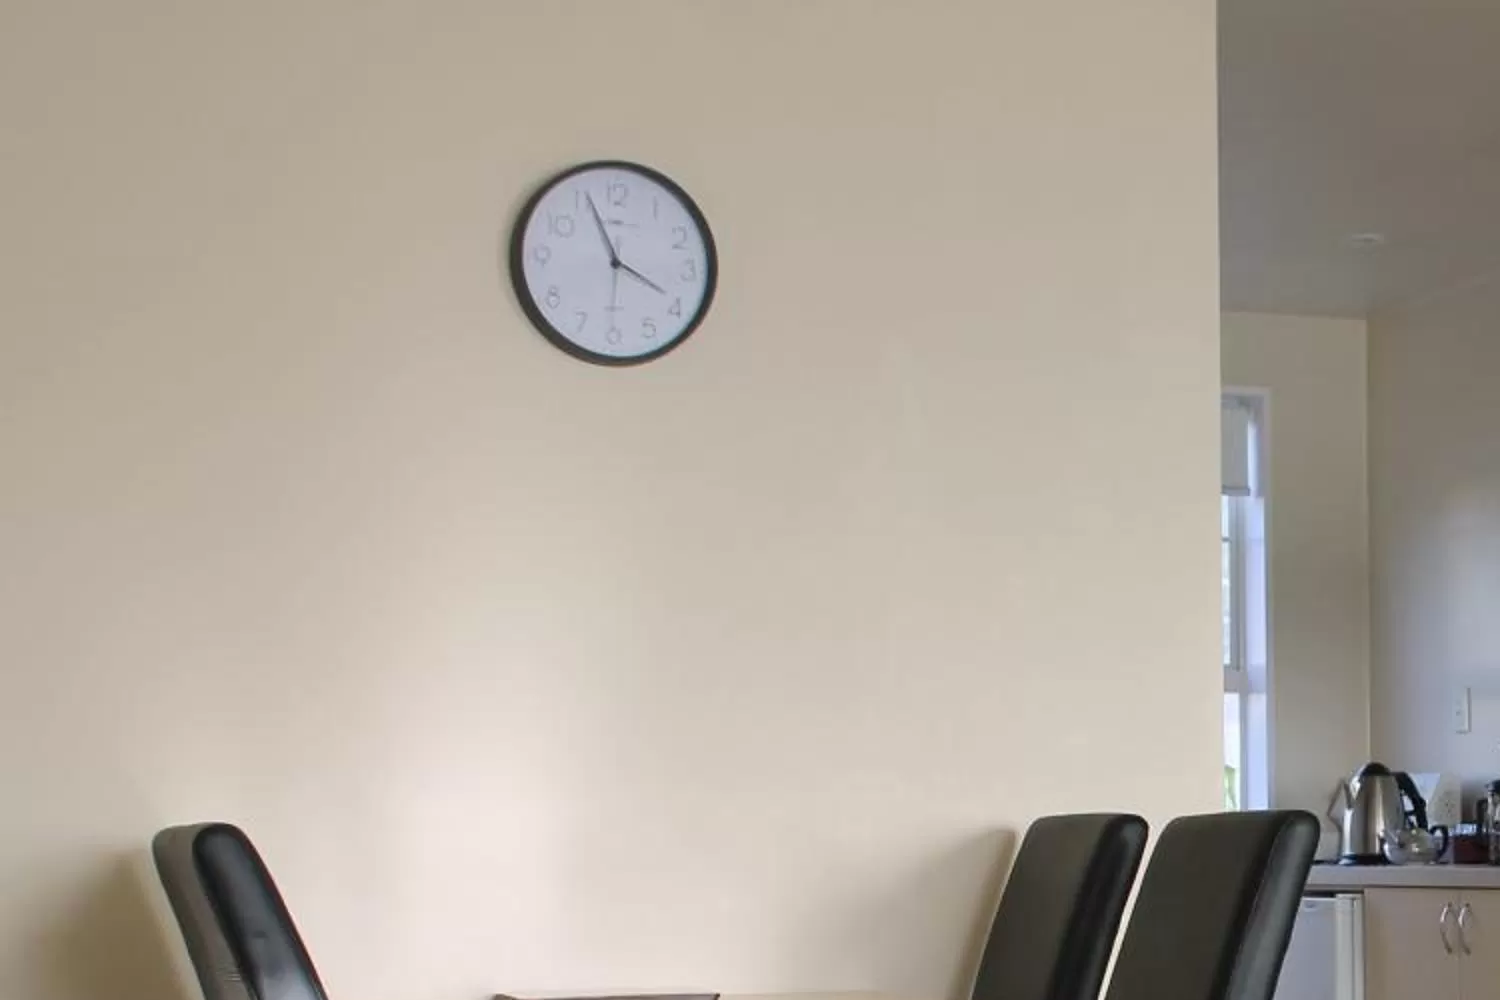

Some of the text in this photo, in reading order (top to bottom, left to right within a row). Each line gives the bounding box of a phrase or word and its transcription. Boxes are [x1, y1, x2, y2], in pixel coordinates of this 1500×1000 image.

[606, 181, 628, 208] 12
[653, 195, 660, 220] 1
[548, 207, 575, 239] 10
[671, 225, 689, 251] 2
[533, 244, 552, 268] 9
[680, 258, 697, 282] 3
[545, 284, 561, 310] 8
[667, 296, 682, 320] 4
[574, 310, 589, 334] 7
[640, 318, 657, 339] 5
[606, 325, 623, 346] 6
